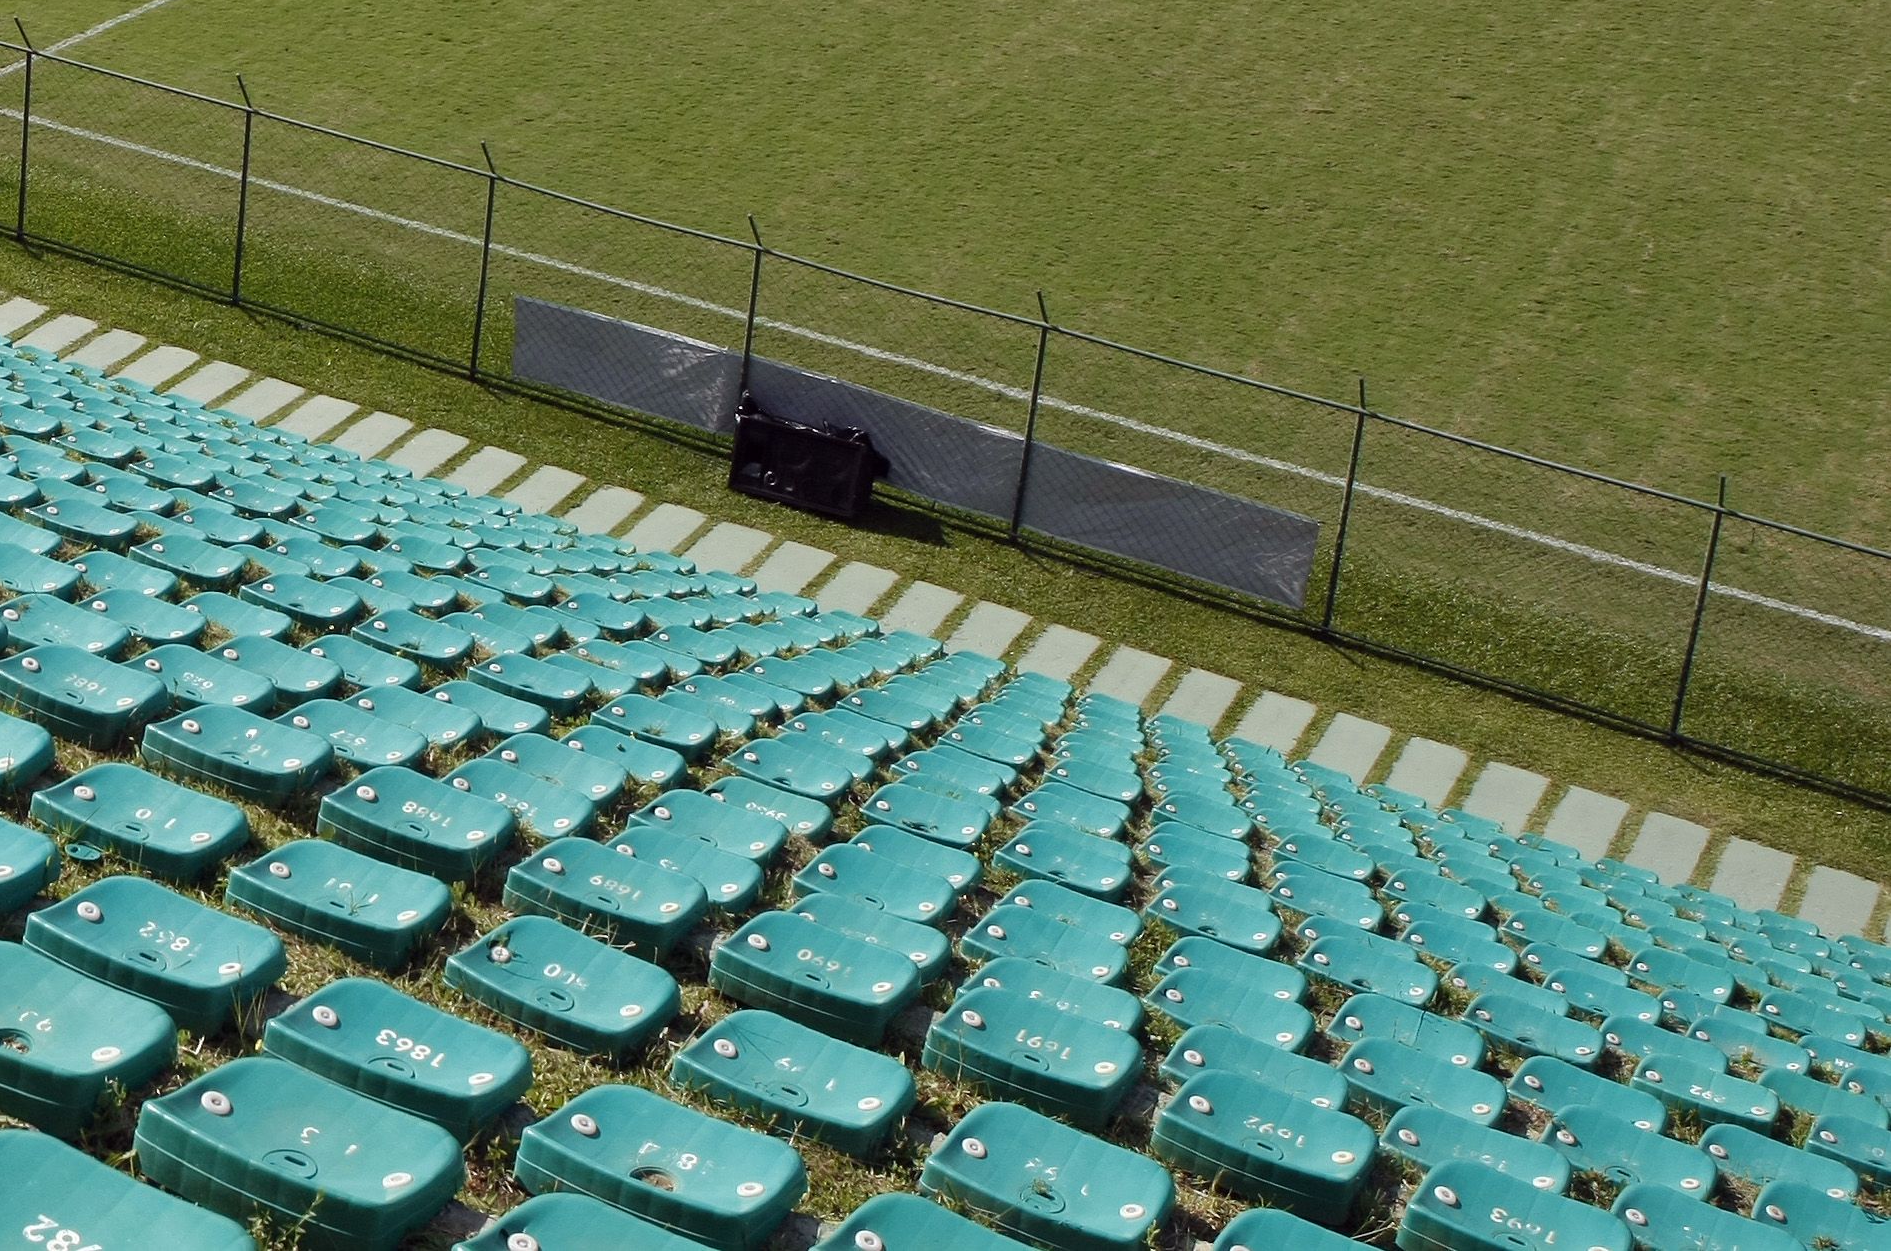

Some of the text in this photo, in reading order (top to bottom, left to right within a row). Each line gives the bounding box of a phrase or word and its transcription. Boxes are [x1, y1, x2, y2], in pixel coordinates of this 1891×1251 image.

[590, 875, 642, 901] 1689
[376, 1029, 446, 1068] 1863
[1015, 1028, 1071, 1060] 1691
